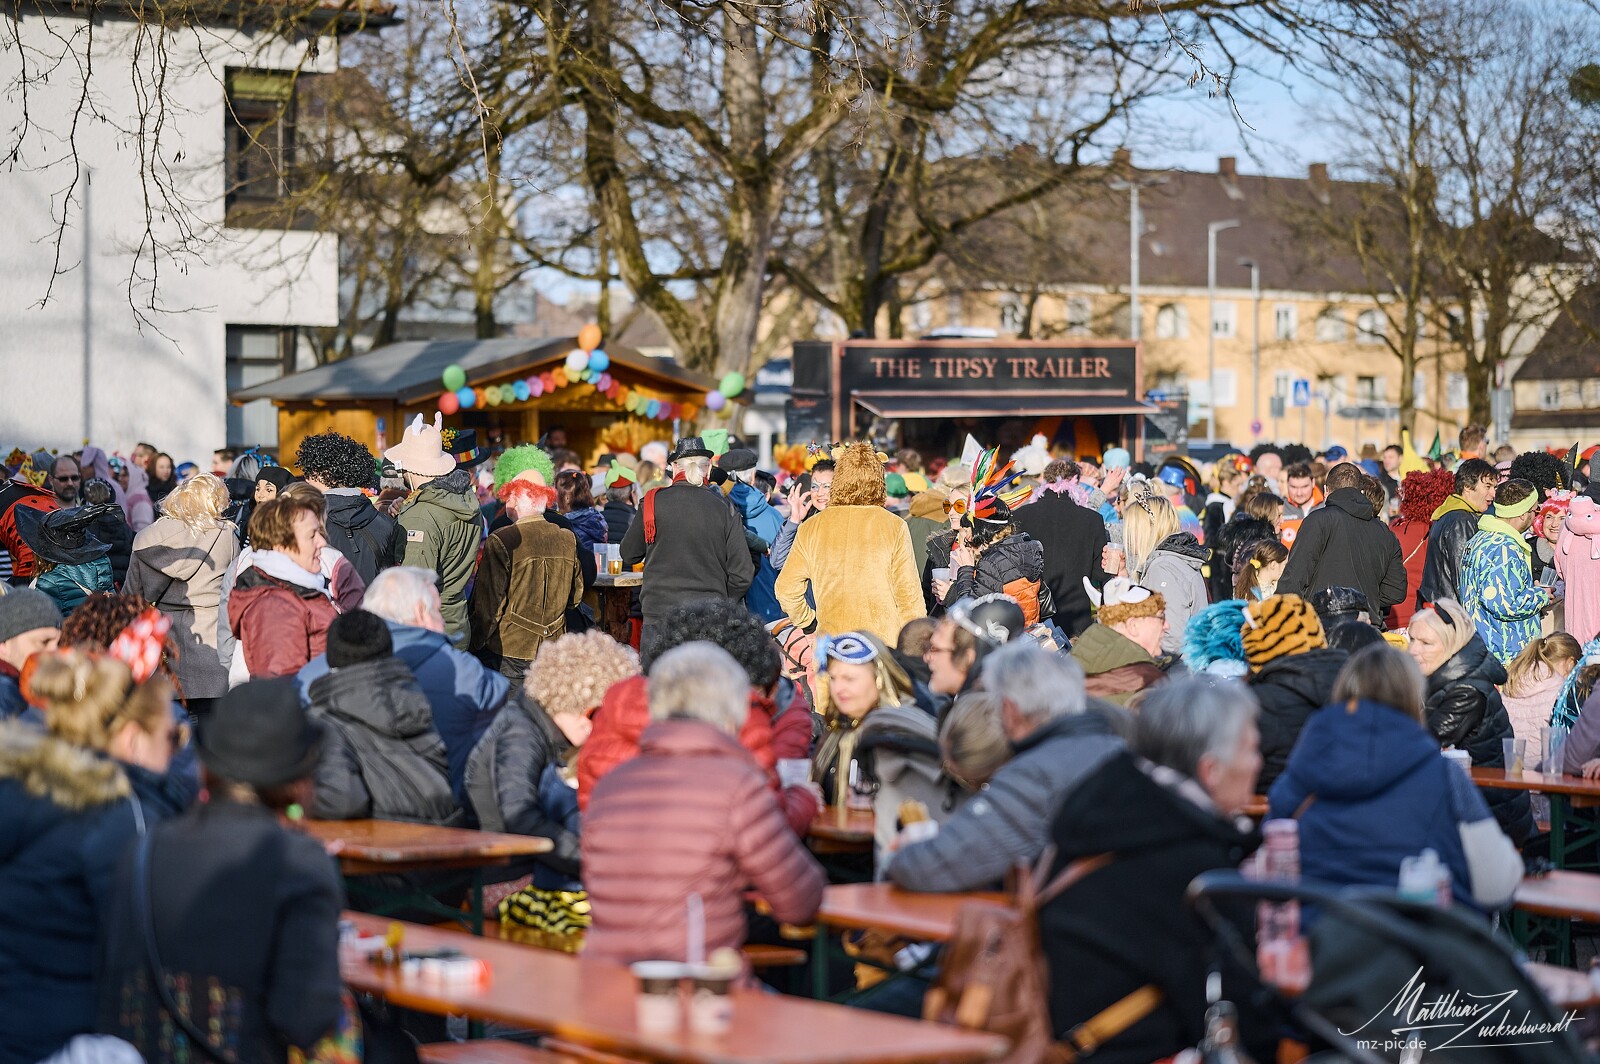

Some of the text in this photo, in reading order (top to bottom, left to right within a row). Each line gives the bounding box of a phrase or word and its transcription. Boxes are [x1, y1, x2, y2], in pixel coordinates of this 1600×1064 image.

[870, 356, 1112, 379] THE TIPSY TRAILER
